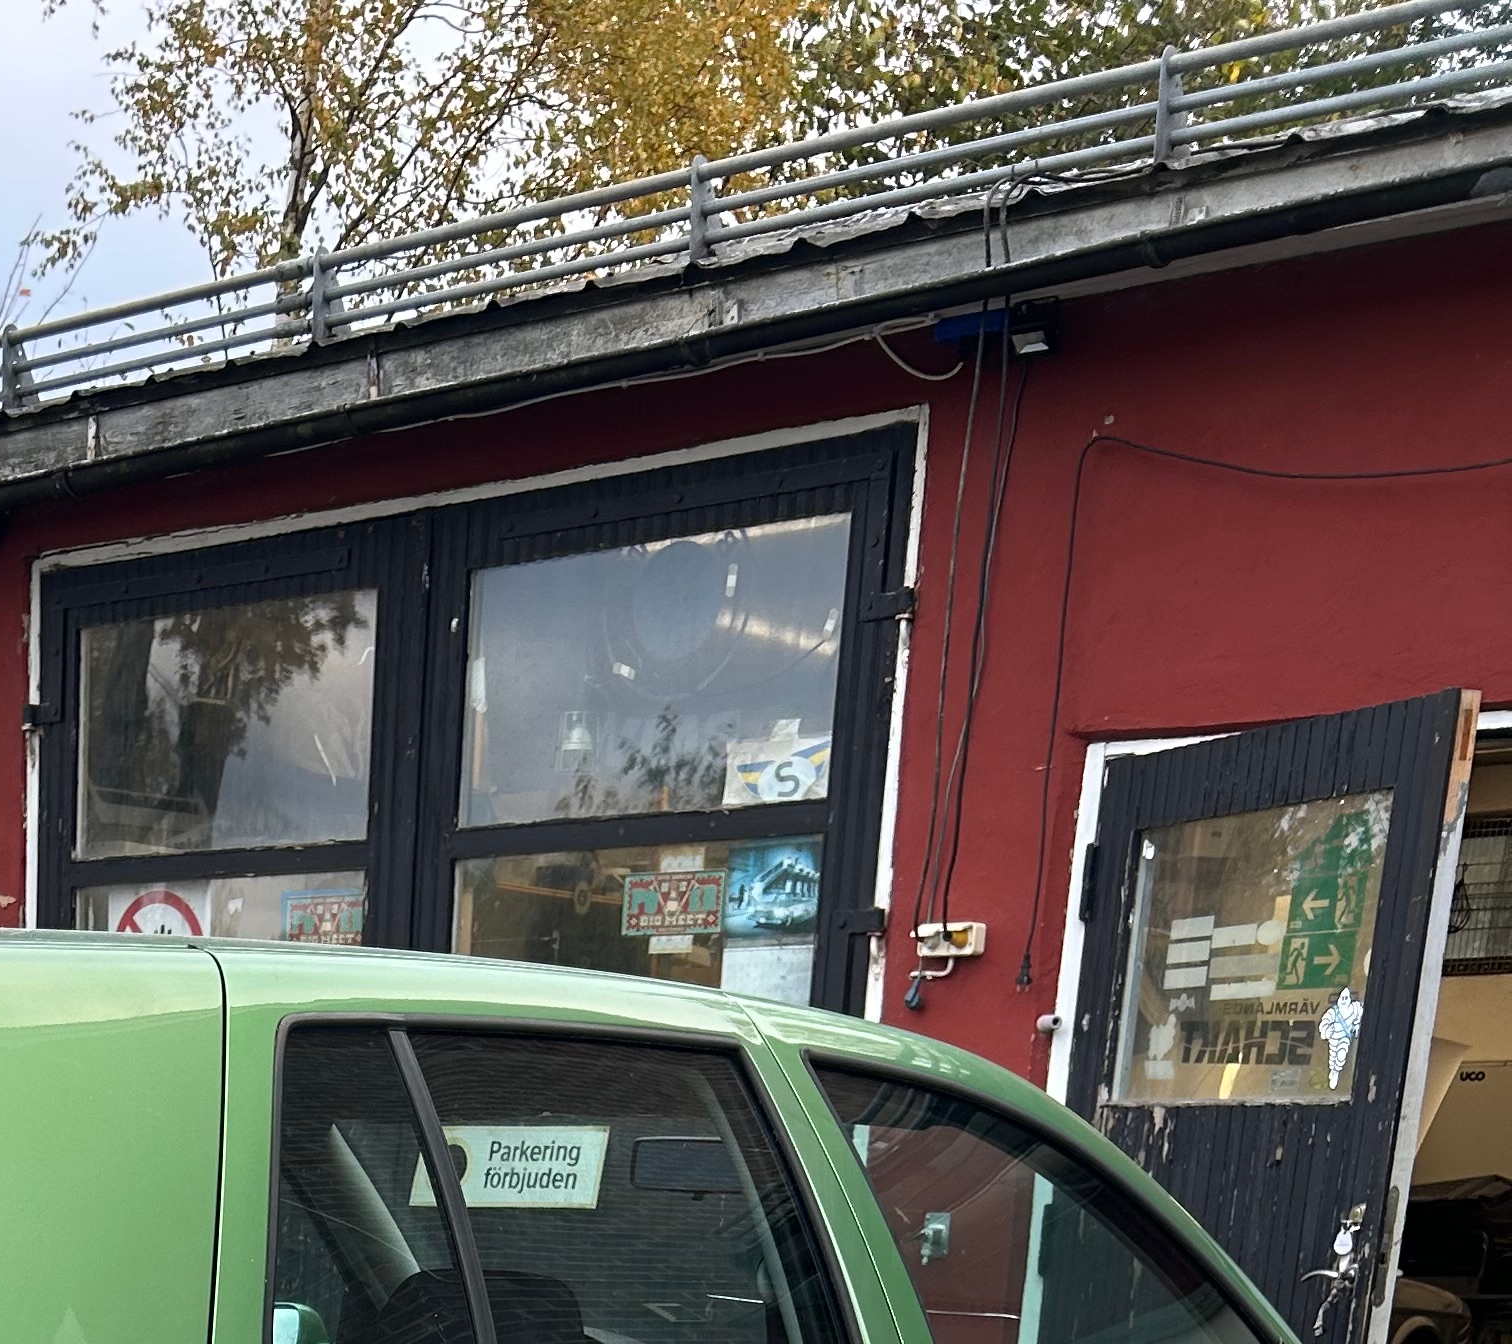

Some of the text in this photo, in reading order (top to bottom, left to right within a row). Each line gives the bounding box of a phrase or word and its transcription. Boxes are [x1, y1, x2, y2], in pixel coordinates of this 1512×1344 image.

[774, 760, 801, 798] S
[488, 1139, 581, 1167] Parkering
[483, 1166, 578, 1194] förbjuden
